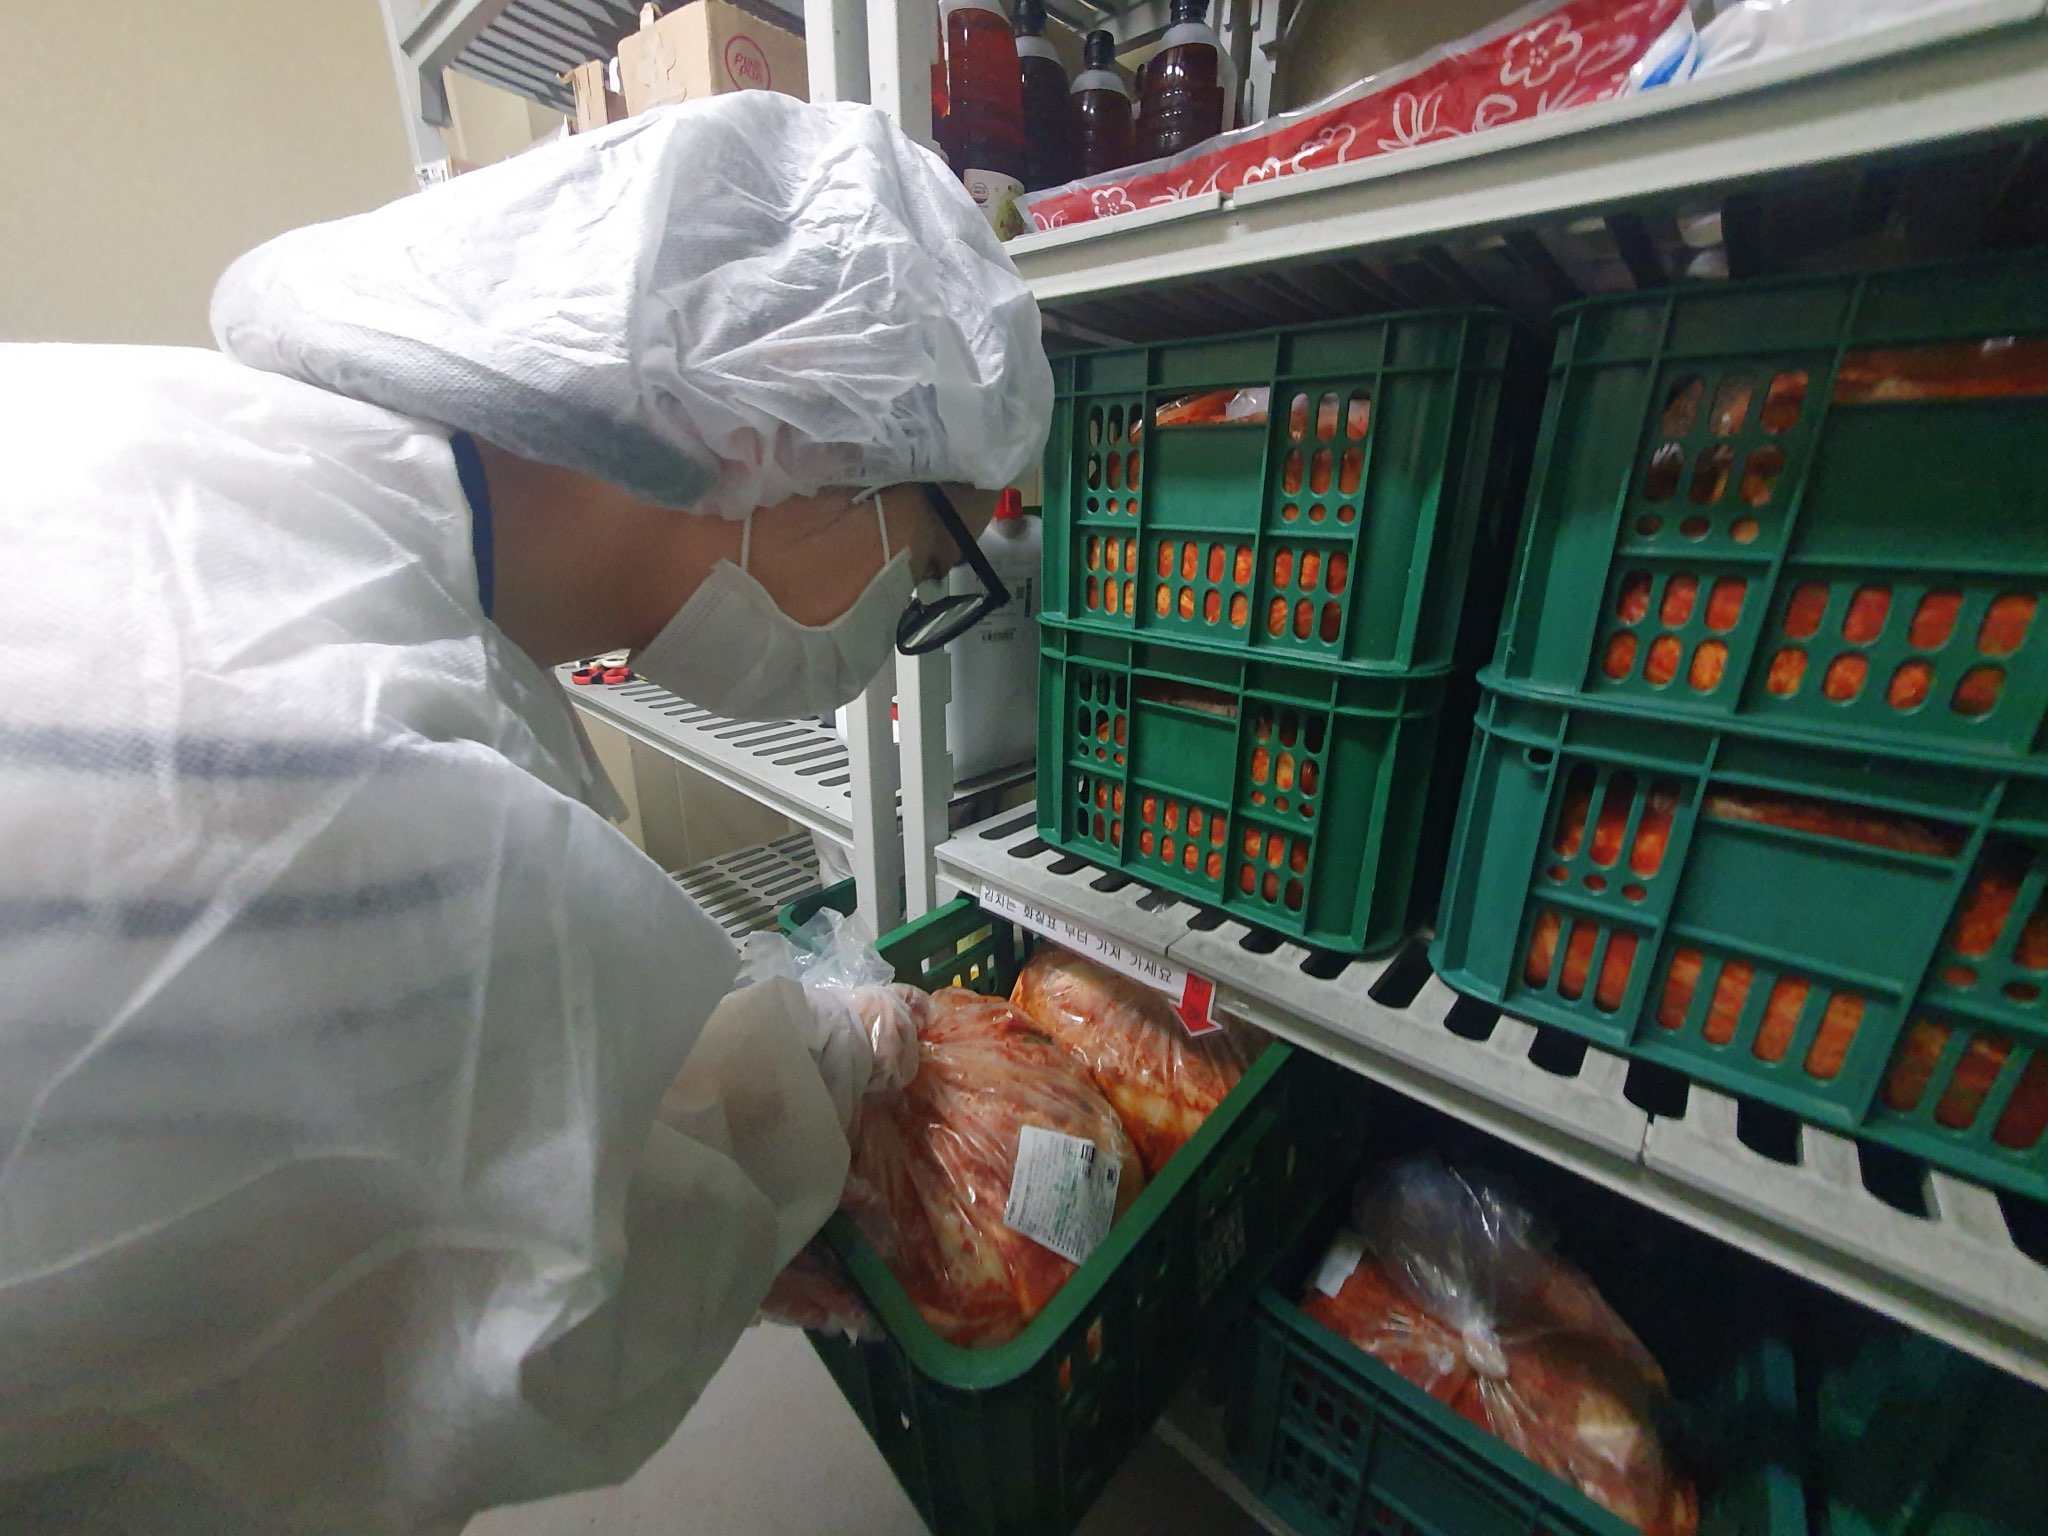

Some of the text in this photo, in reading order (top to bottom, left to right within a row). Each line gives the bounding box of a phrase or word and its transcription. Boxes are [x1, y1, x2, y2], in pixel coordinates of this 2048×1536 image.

[985, 886, 1016, 913] 김치는
[1065, 922, 1088, 946] 부터
[1130, 952, 1172, 984] 가세요
